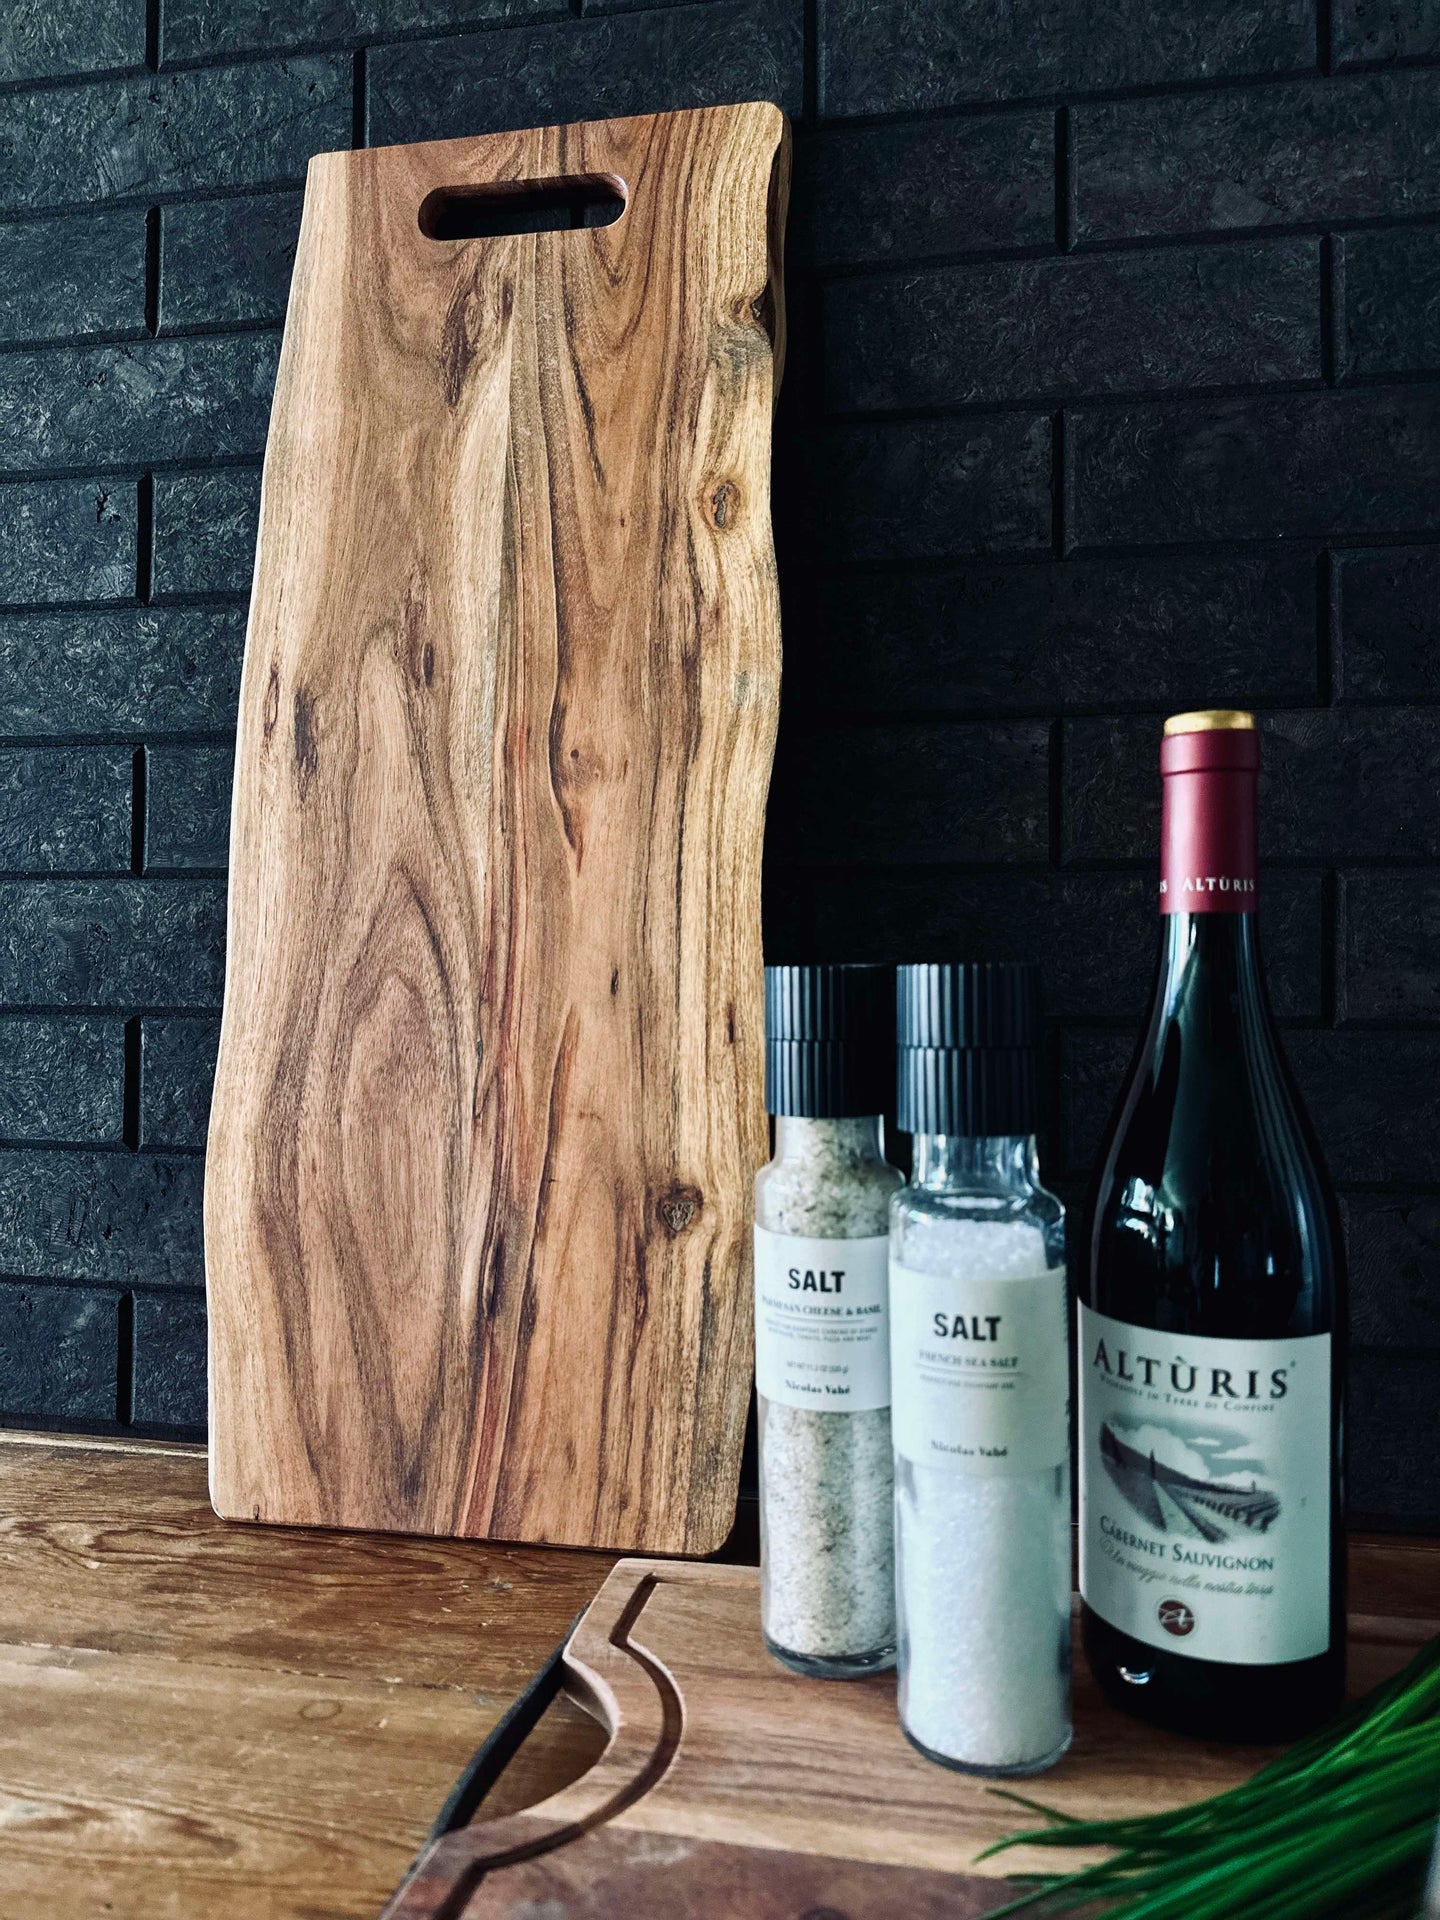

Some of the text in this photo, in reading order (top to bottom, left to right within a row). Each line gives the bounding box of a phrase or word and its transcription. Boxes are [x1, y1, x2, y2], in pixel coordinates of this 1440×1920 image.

[788, 1268, 845, 1293] SALT
[803, 1304, 843, 1316] CHEESE
[846, 1307, 854, 1316] &
[934, 1313, 1002, 1341] SALT
[1093, 1338, 1288, 1400] ALTÙRIS
[785, 1379, 822, 1394] Nicolas
[931, 1440, 974, 1456] Nicolas
[1100, 1515, 1274, 1571] CABERNET SAUVIGNON
